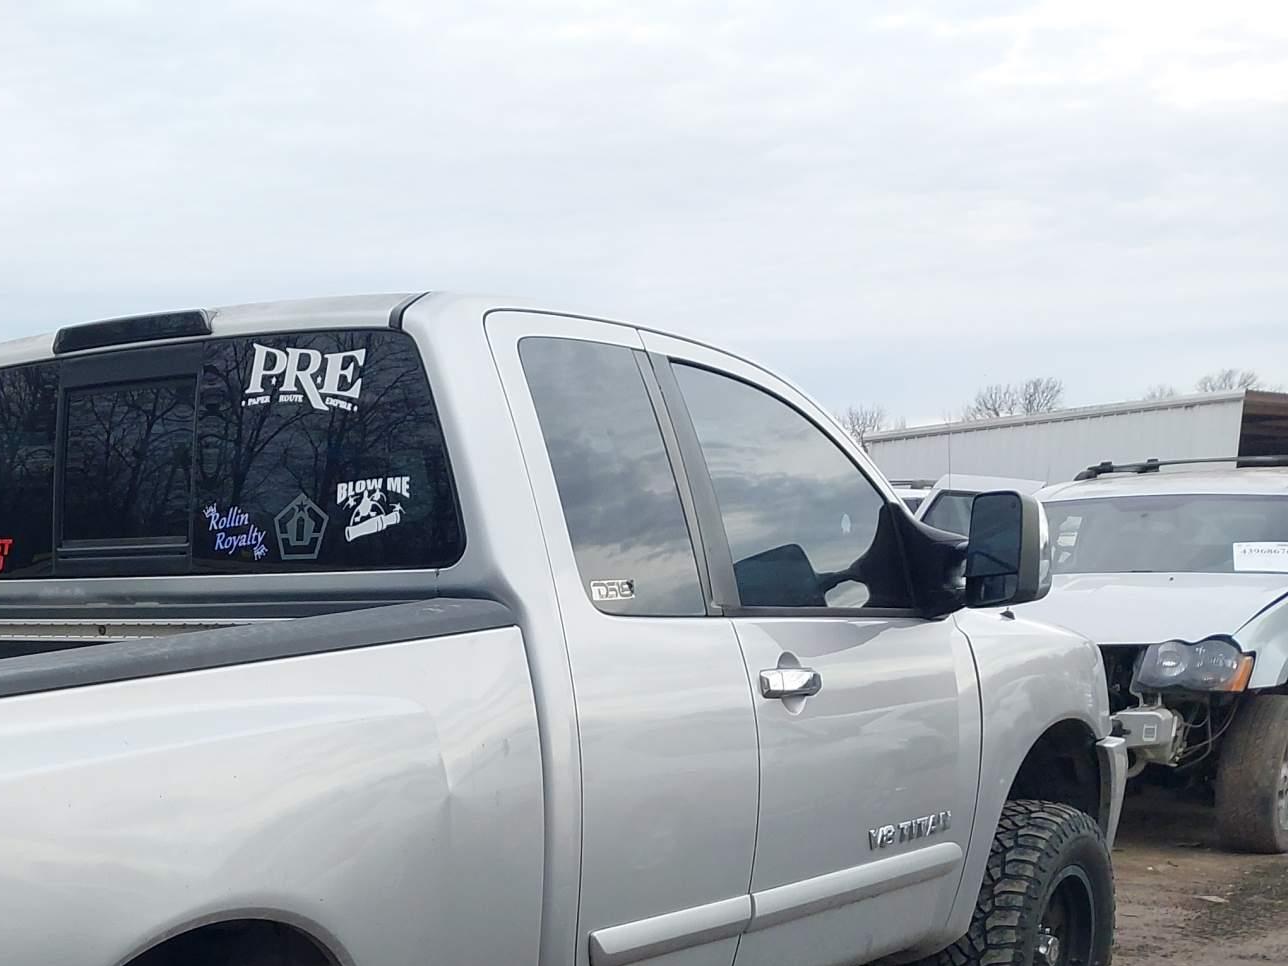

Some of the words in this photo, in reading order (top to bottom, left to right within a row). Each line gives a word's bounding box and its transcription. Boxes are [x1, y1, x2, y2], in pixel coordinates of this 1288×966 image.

[245, 342, 366, 411] PRE
[278, 394, 304, 403] ROUTE
[336, 478, 383, 505] BLOW
[387, 476, 410, 499] ME
[208, 506, 249, 531] Rollin
[214, 524, 267, 555] Royalty
[868, 824, 896, 850] V8
[897, 810, 952, 843] TITAN
